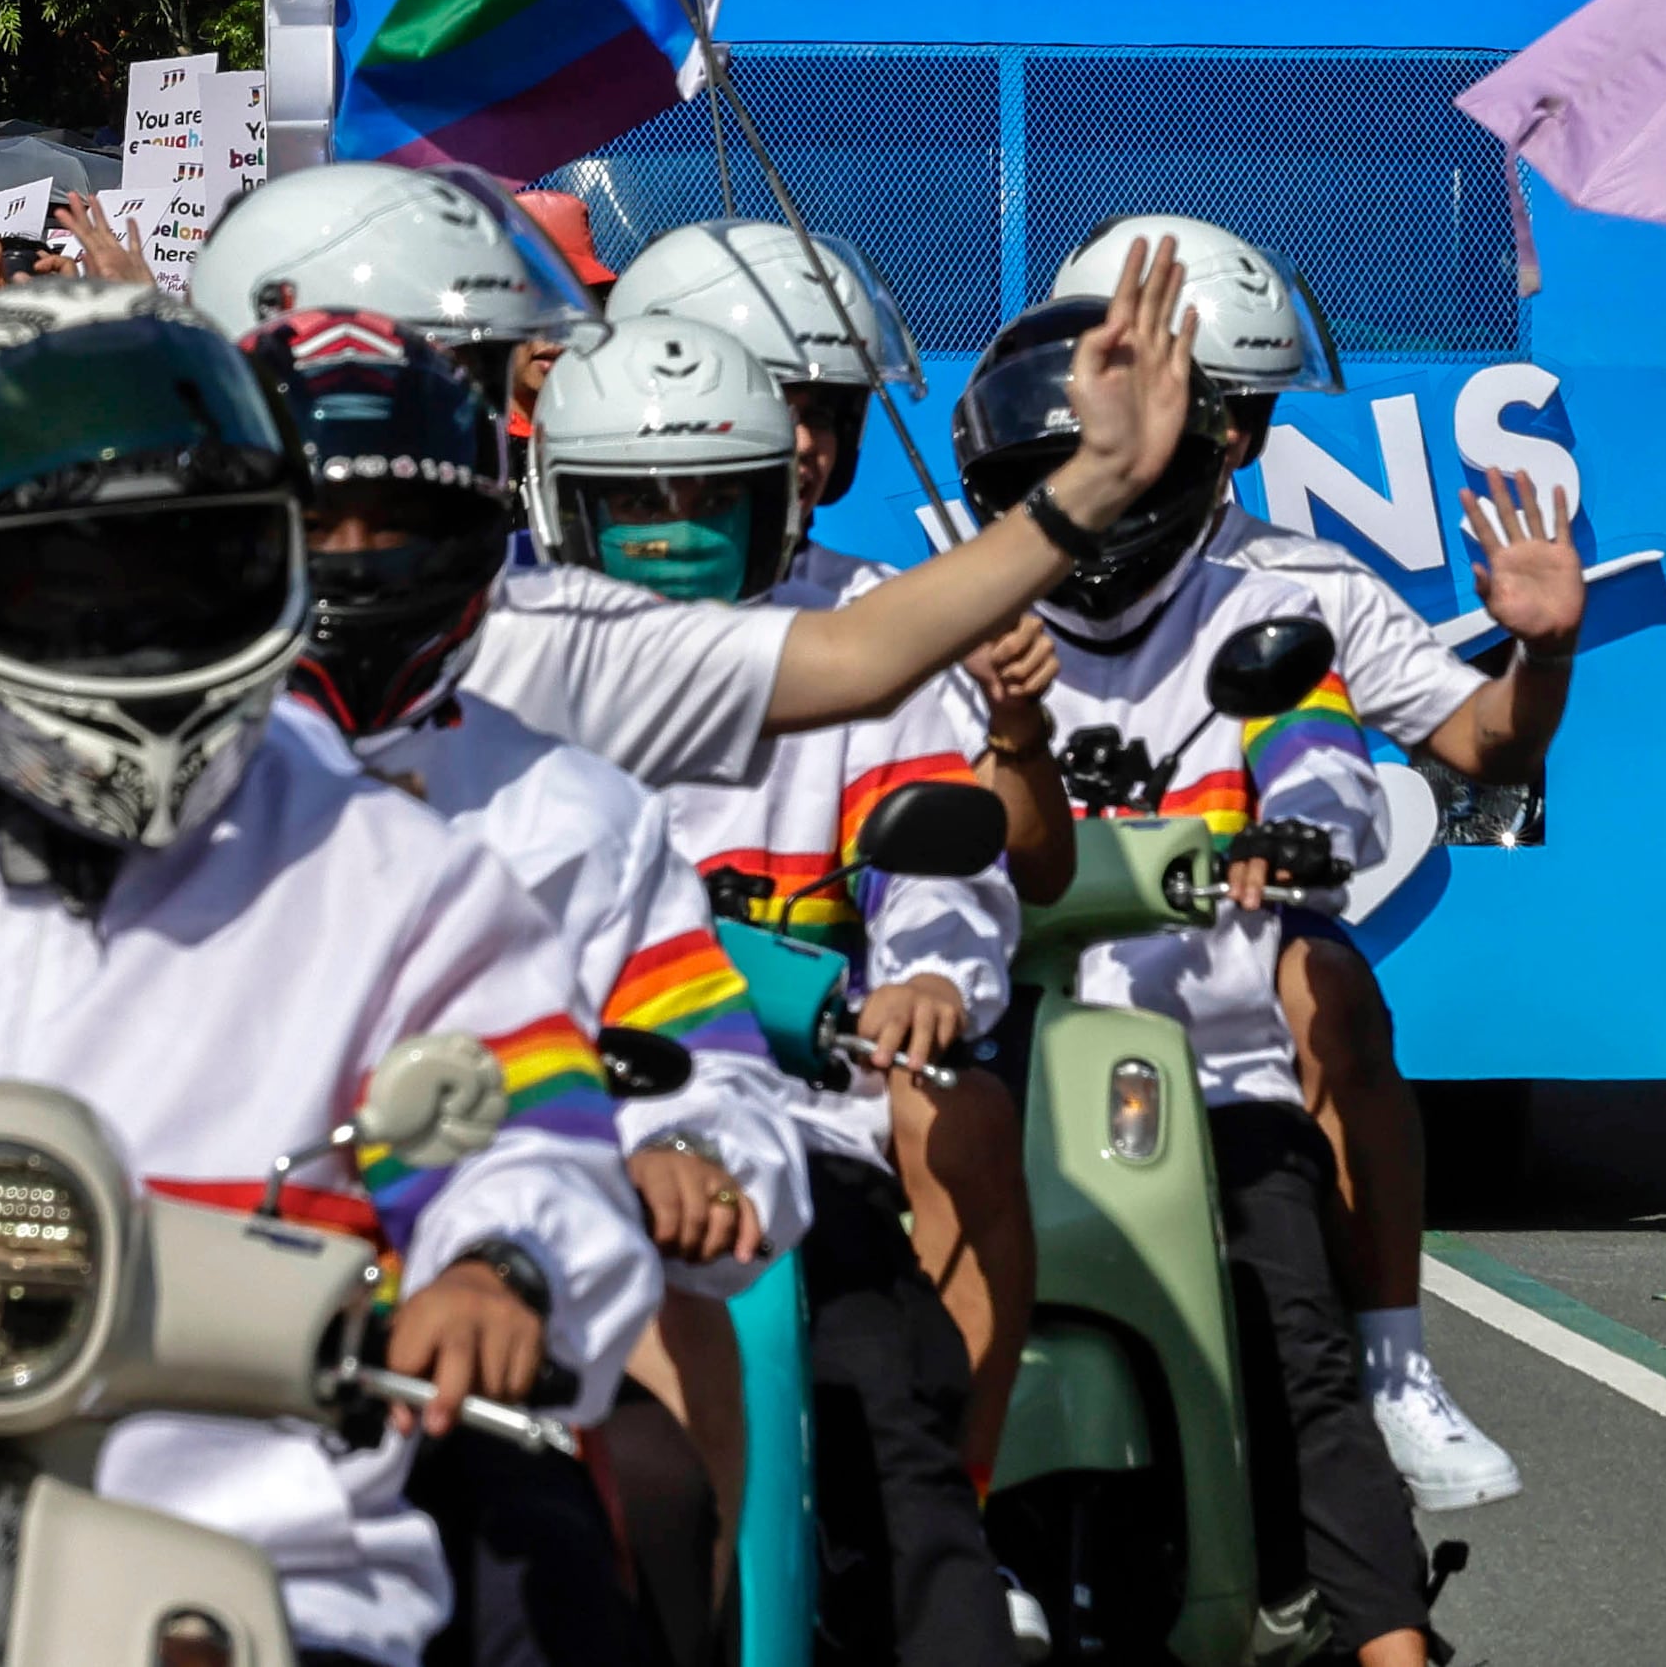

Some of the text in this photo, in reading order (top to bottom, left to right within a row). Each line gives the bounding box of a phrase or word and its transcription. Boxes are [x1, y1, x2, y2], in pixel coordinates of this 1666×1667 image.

[136, 109, 202, 131] You are
[170, 196, 205, 218] You
[152, 220, 211, 242] elon
